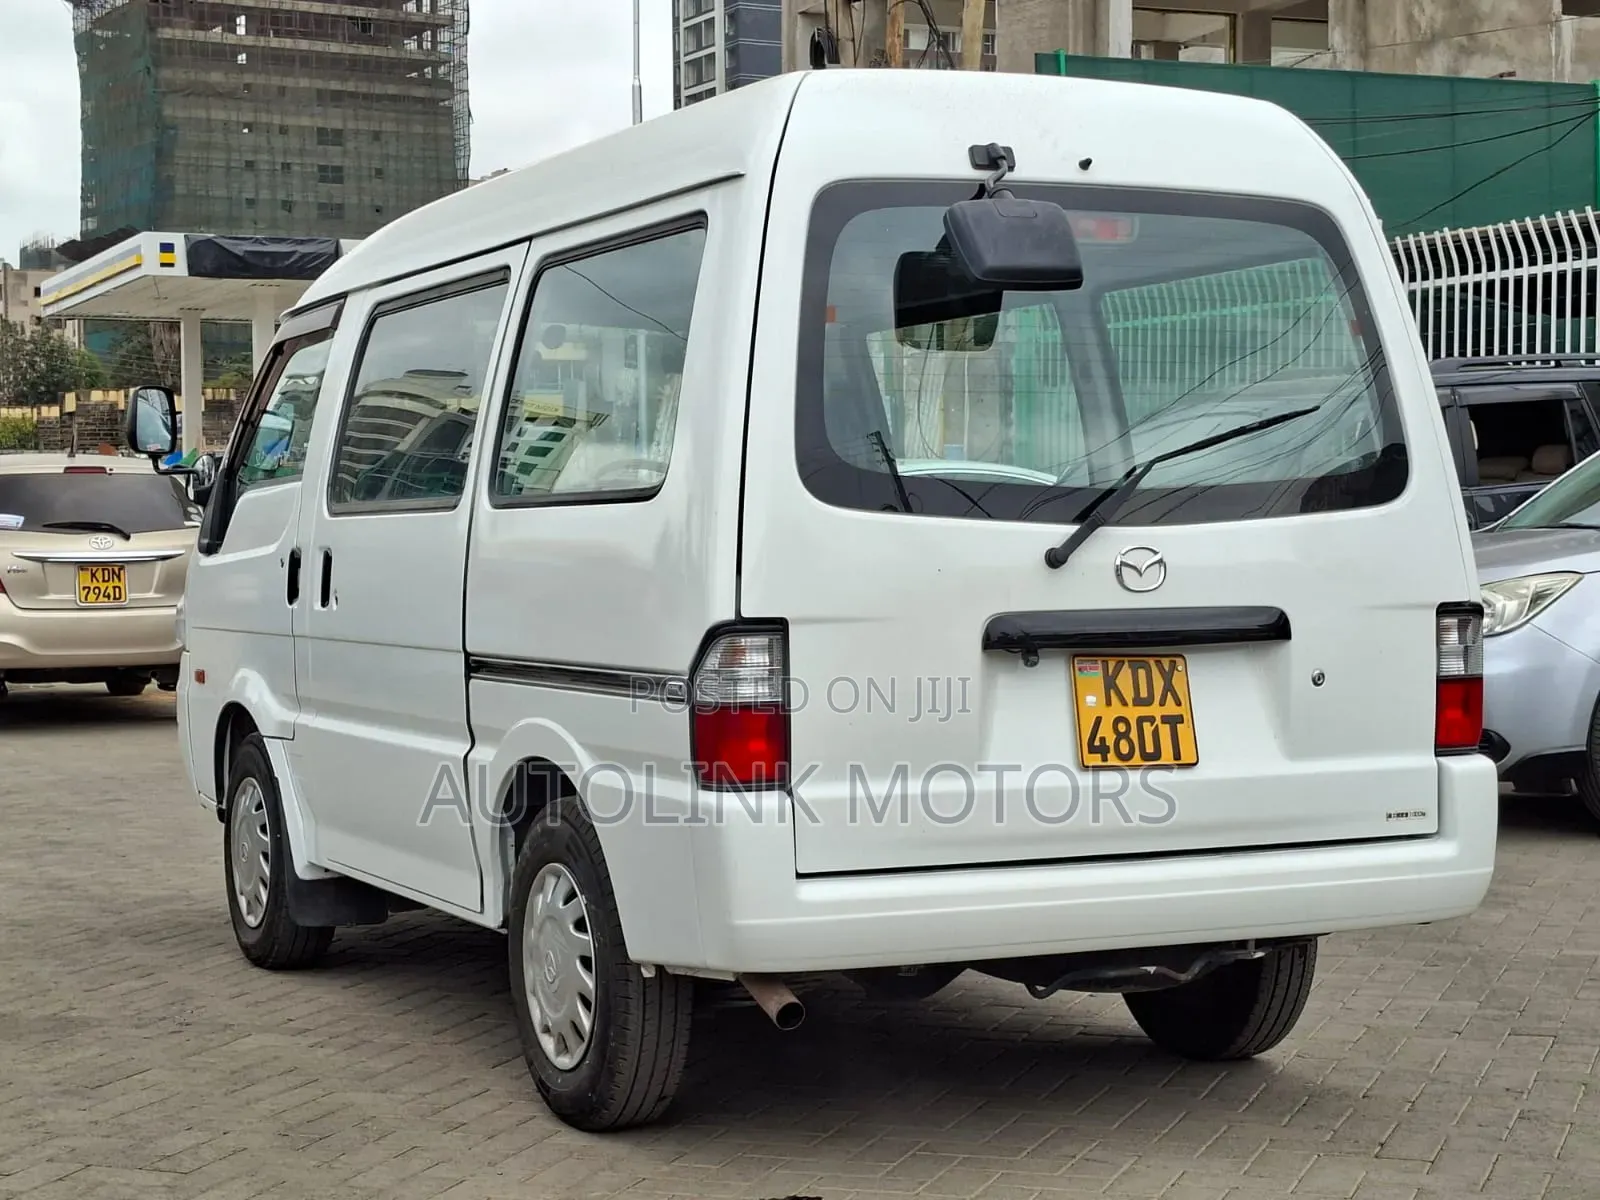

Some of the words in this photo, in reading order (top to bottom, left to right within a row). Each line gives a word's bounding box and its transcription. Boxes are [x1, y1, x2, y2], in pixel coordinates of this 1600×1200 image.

[90, 567, 122, 583] KDN
[82, 585, 122, 601] 794D
[1101, 659, 1182, 707] KDX
[1087, 714, 1185, 763] 480T
